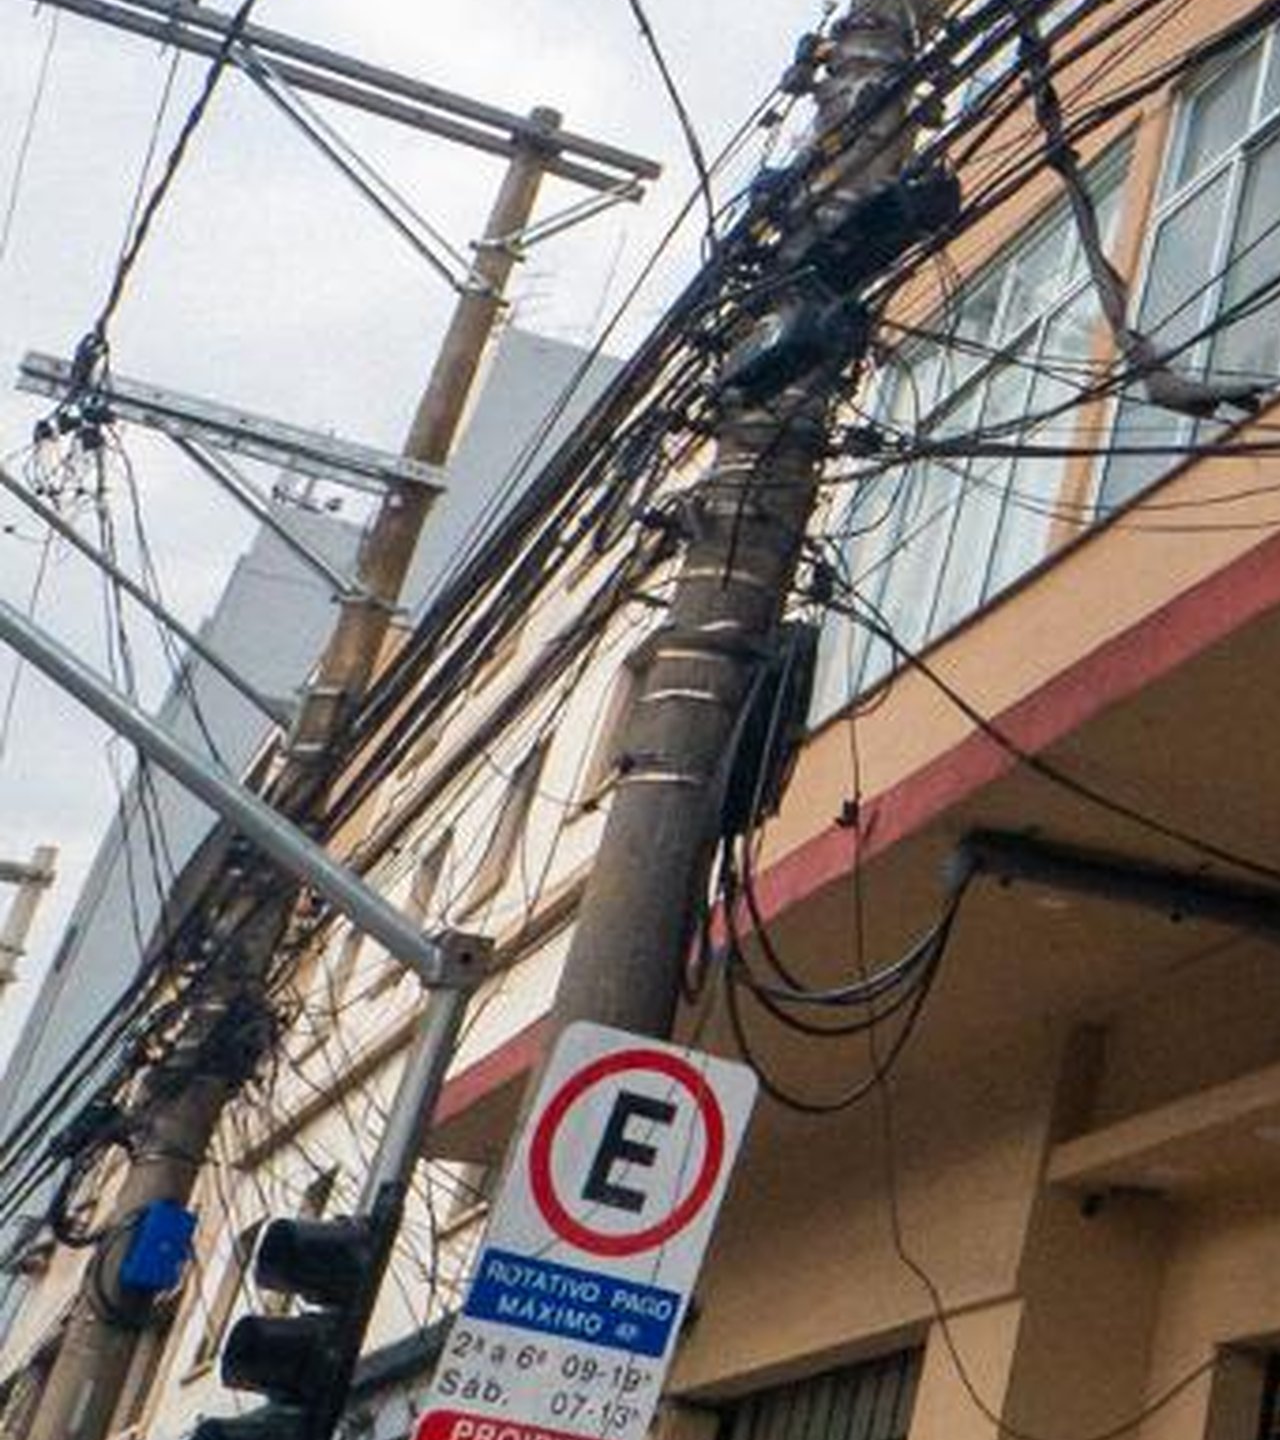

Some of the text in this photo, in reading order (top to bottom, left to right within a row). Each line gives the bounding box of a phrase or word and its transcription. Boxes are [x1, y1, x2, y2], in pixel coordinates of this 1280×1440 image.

[582, 1091, 676, 1215] E
[486, 1260, 673, 1321] ROTATIVO PAGO
[490, 1346, 507, 1364] a
